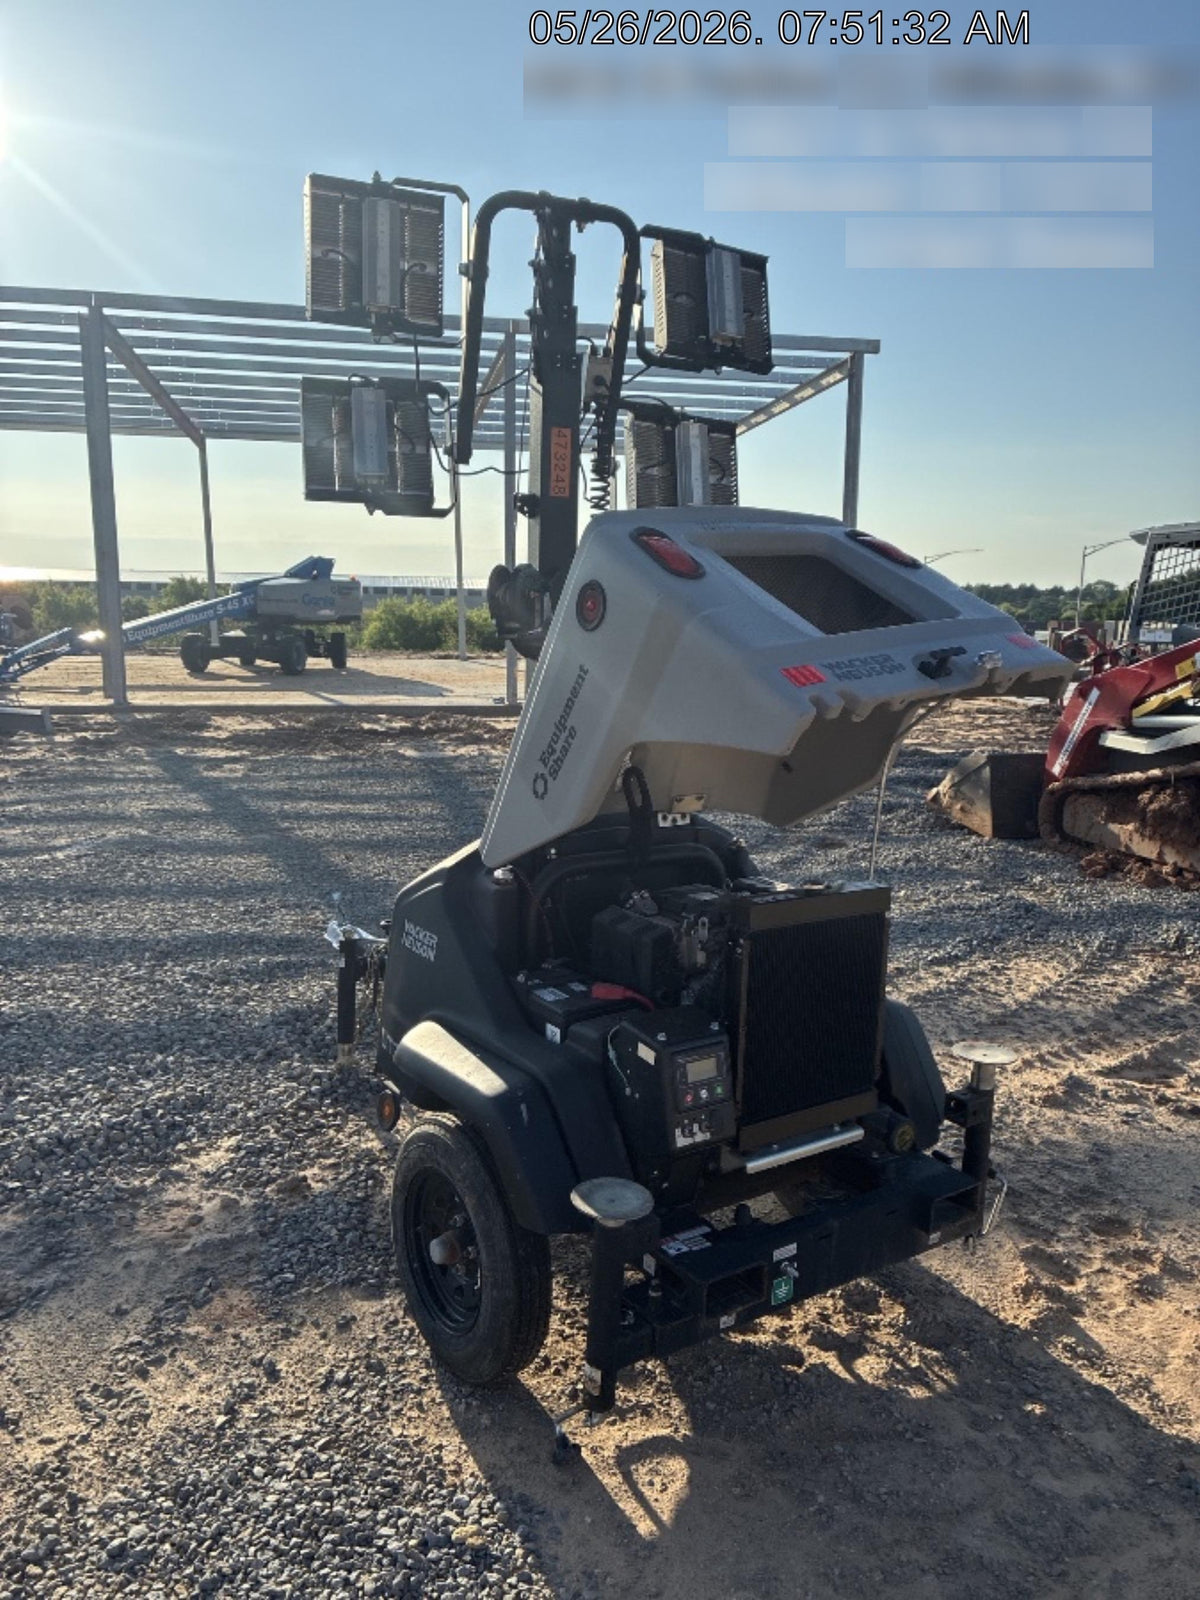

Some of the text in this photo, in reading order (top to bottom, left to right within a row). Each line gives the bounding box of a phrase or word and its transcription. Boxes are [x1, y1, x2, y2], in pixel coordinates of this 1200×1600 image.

[552, 429, 568, 495] 473248
[216, 597, 239, 615] S-45
[820, 653, 895, 671] WACKER
[832, 662, 906, 682] NEUSON
[538, 663, 590, 769] Equipment
[547, 724, 577, 781] Share
[401, 932, 437, 962] NEUSON
